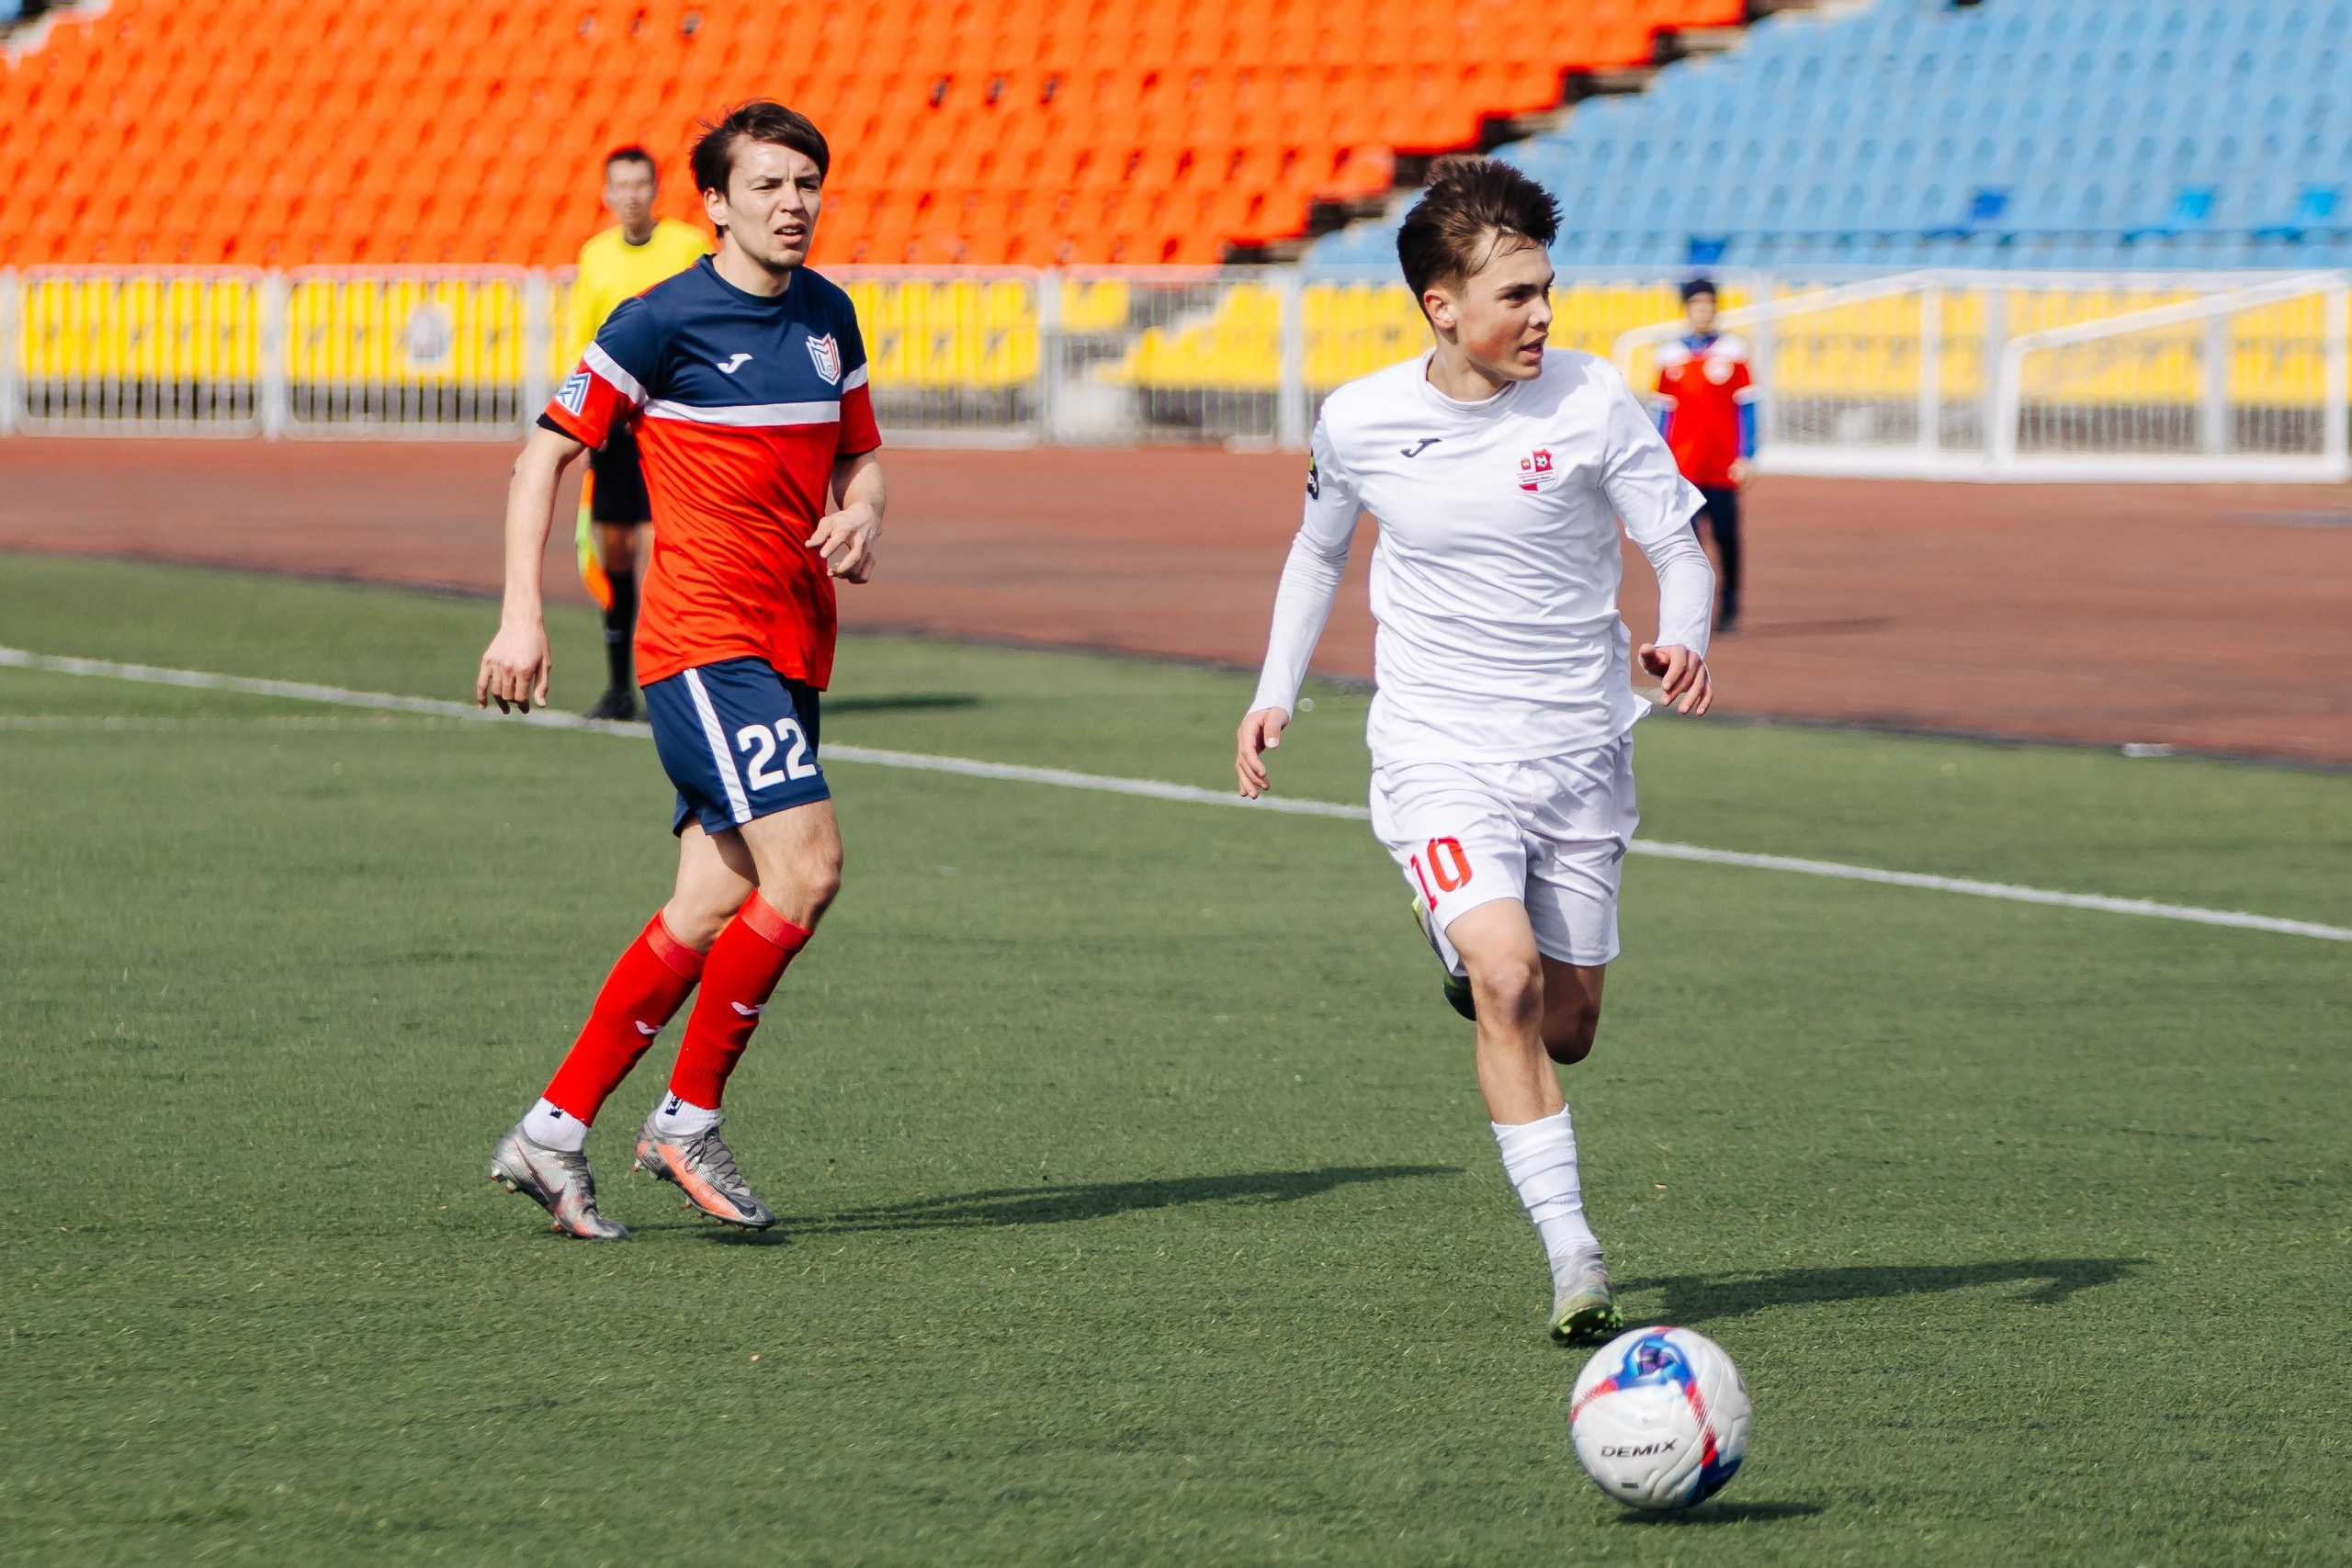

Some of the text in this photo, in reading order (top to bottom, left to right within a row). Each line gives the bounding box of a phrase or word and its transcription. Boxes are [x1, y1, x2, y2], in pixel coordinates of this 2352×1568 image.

[737, 717, 817, 791] 22
[1409, 836, 1472, 913] 10
[1600, 1438, 1677, 1457] DEMIX
